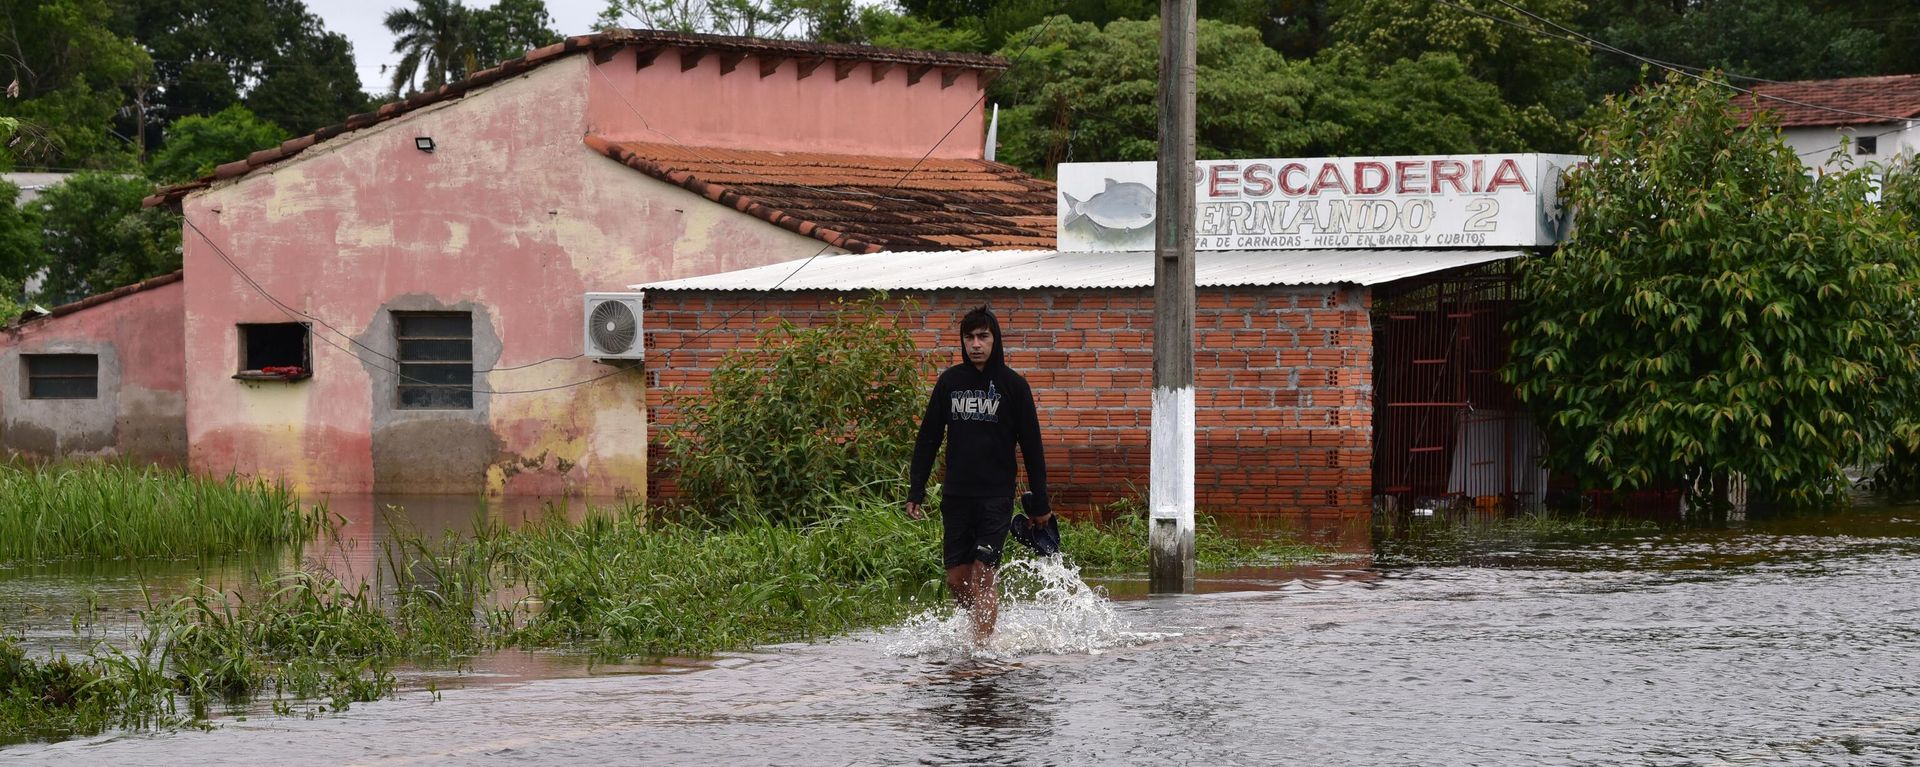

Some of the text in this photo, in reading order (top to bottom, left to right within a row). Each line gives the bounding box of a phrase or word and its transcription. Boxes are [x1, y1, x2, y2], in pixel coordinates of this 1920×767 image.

[1195, 198, 1500, 236] ERNANDO 2
[1216, 237, 1230, 248] DE
[1237, 235, 1301, 247] CARNADAS
[1314, 235, 1350, 246] HIELO
[1356, 234, 1374, 247] EN
[1378, 234, 1418, 246] BARRA
[1424, 233, 1431, 244] Y
[1436, 233, 1486, 245] CUBITOS
[951, 397, 1000, 415] NEW
